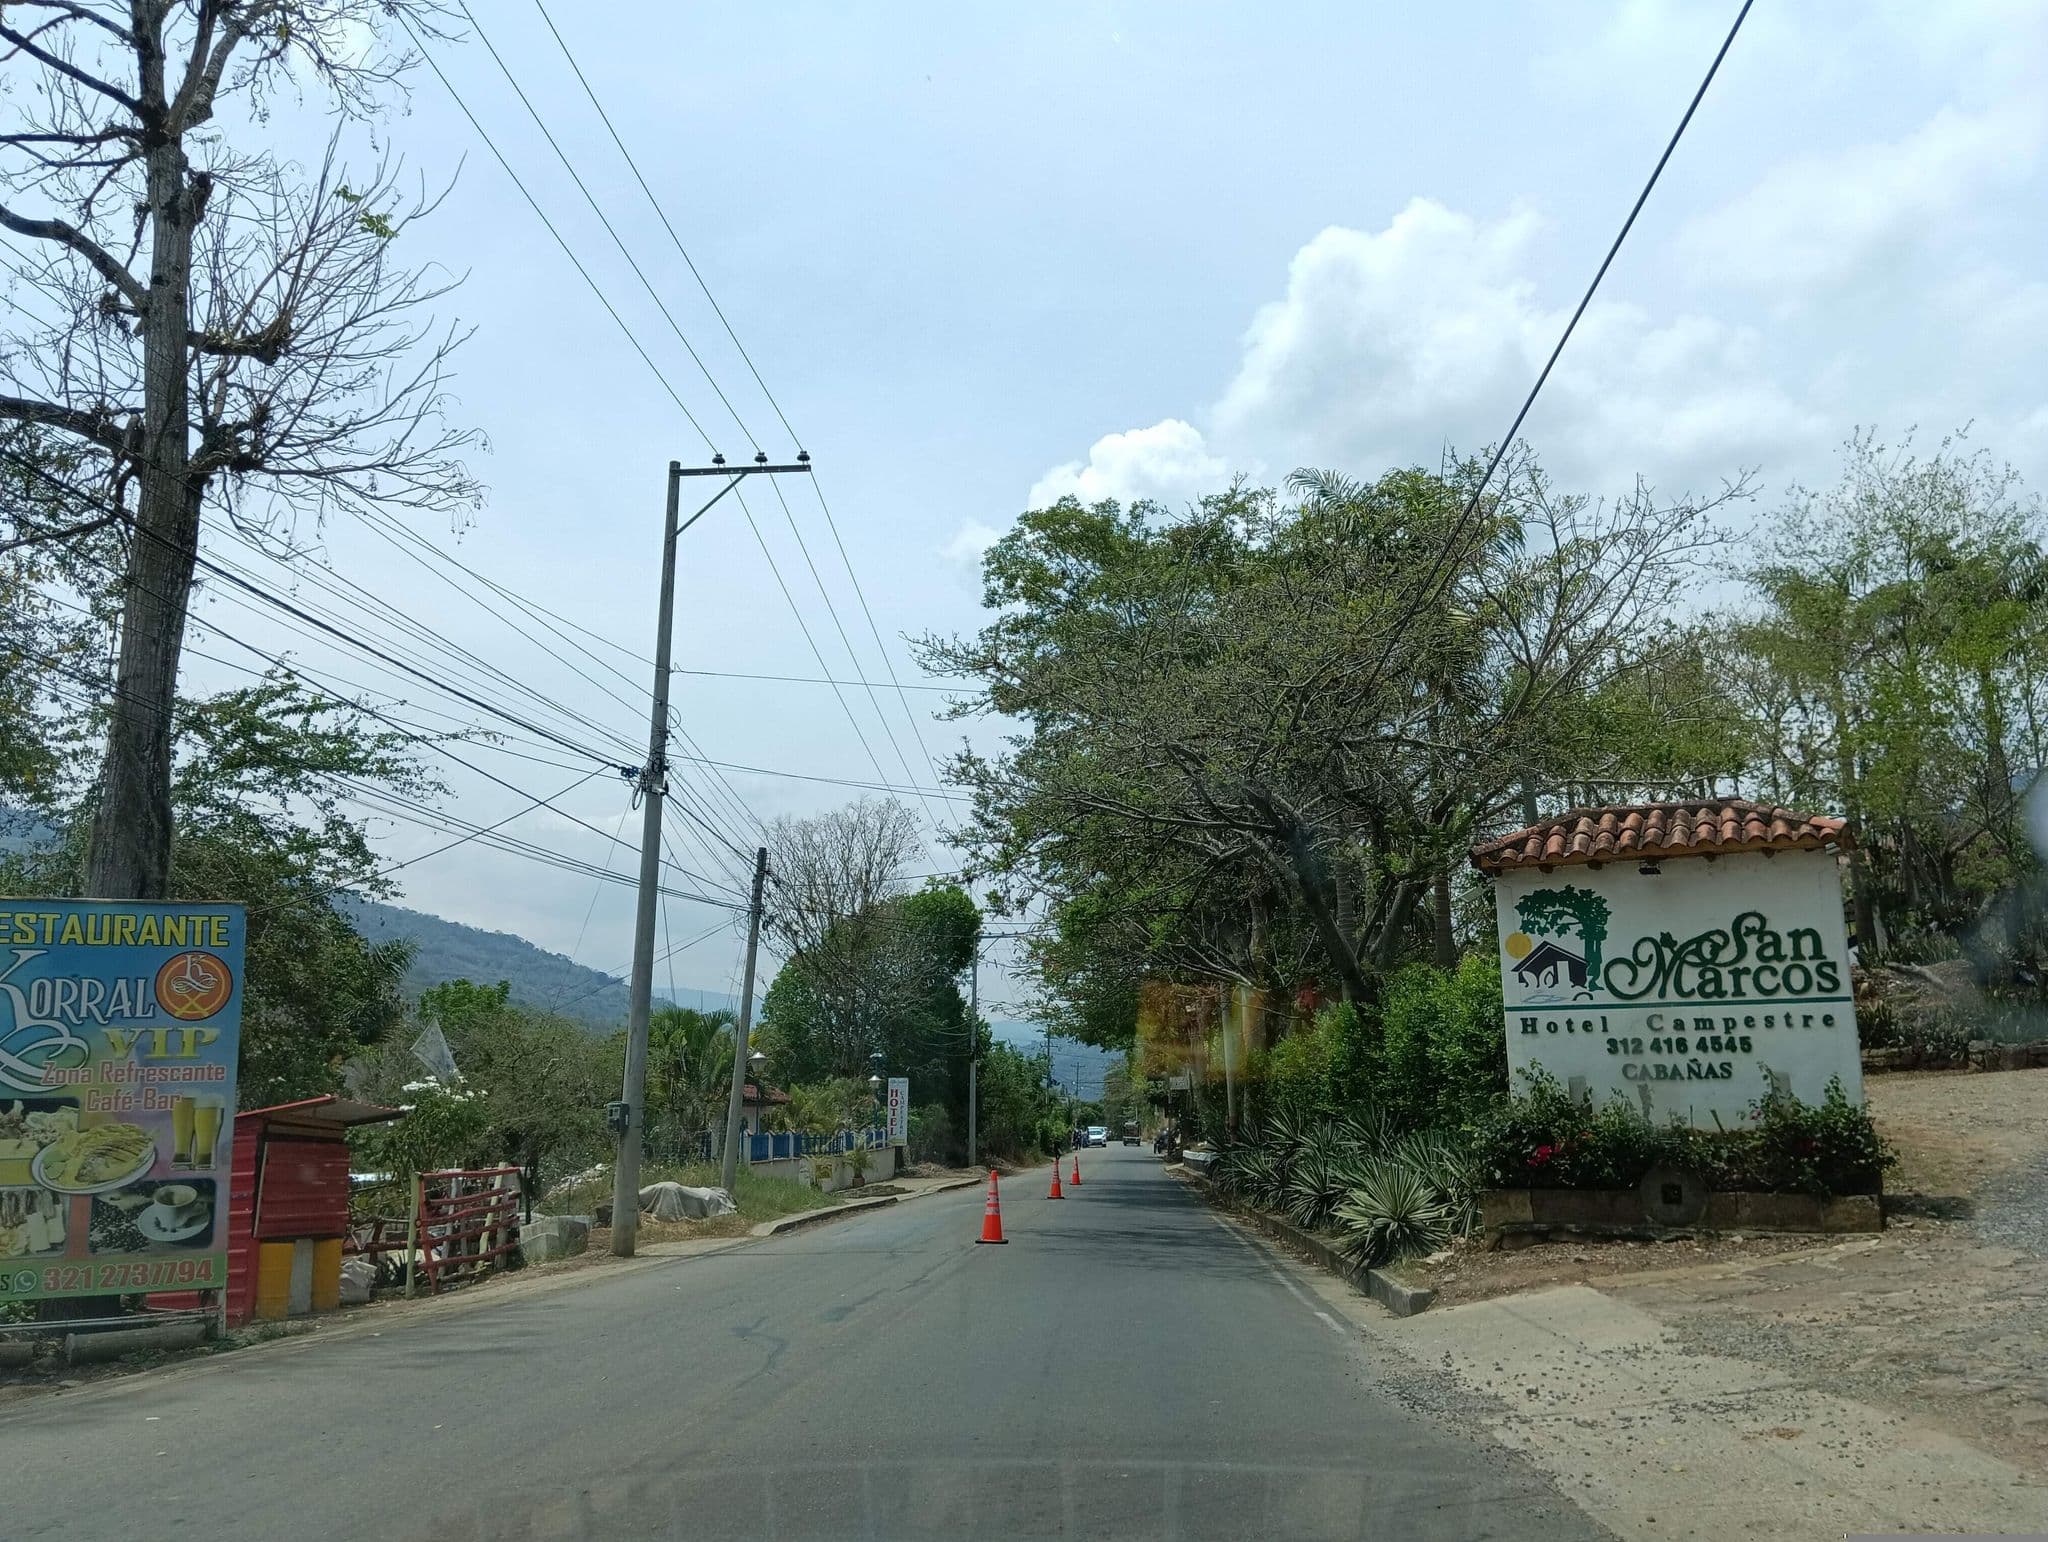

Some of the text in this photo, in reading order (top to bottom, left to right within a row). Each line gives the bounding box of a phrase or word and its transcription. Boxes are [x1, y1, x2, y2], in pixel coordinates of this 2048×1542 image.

[1688, 911, 1828, 967] San
[1603, 928, 1841, 1000] Marcos
[1520, 1011, 1836, 1035] Hotel Campestre
[102, 1027, 221, 1059] VIP
[1606, 1035, 1753, 1055] 312 416 4545
[41, 1060, 226, 1085] Zona Refrescante
[1621, 1058, 1734, 1081] CABAÑAS
[85, 1088, 182, 1113] Café-Bar
[890, 1089, 899, 1136] HOTEL
[42, 1265, 94, 1293] 321
[100, 1258, 214, 1289] 2737794
